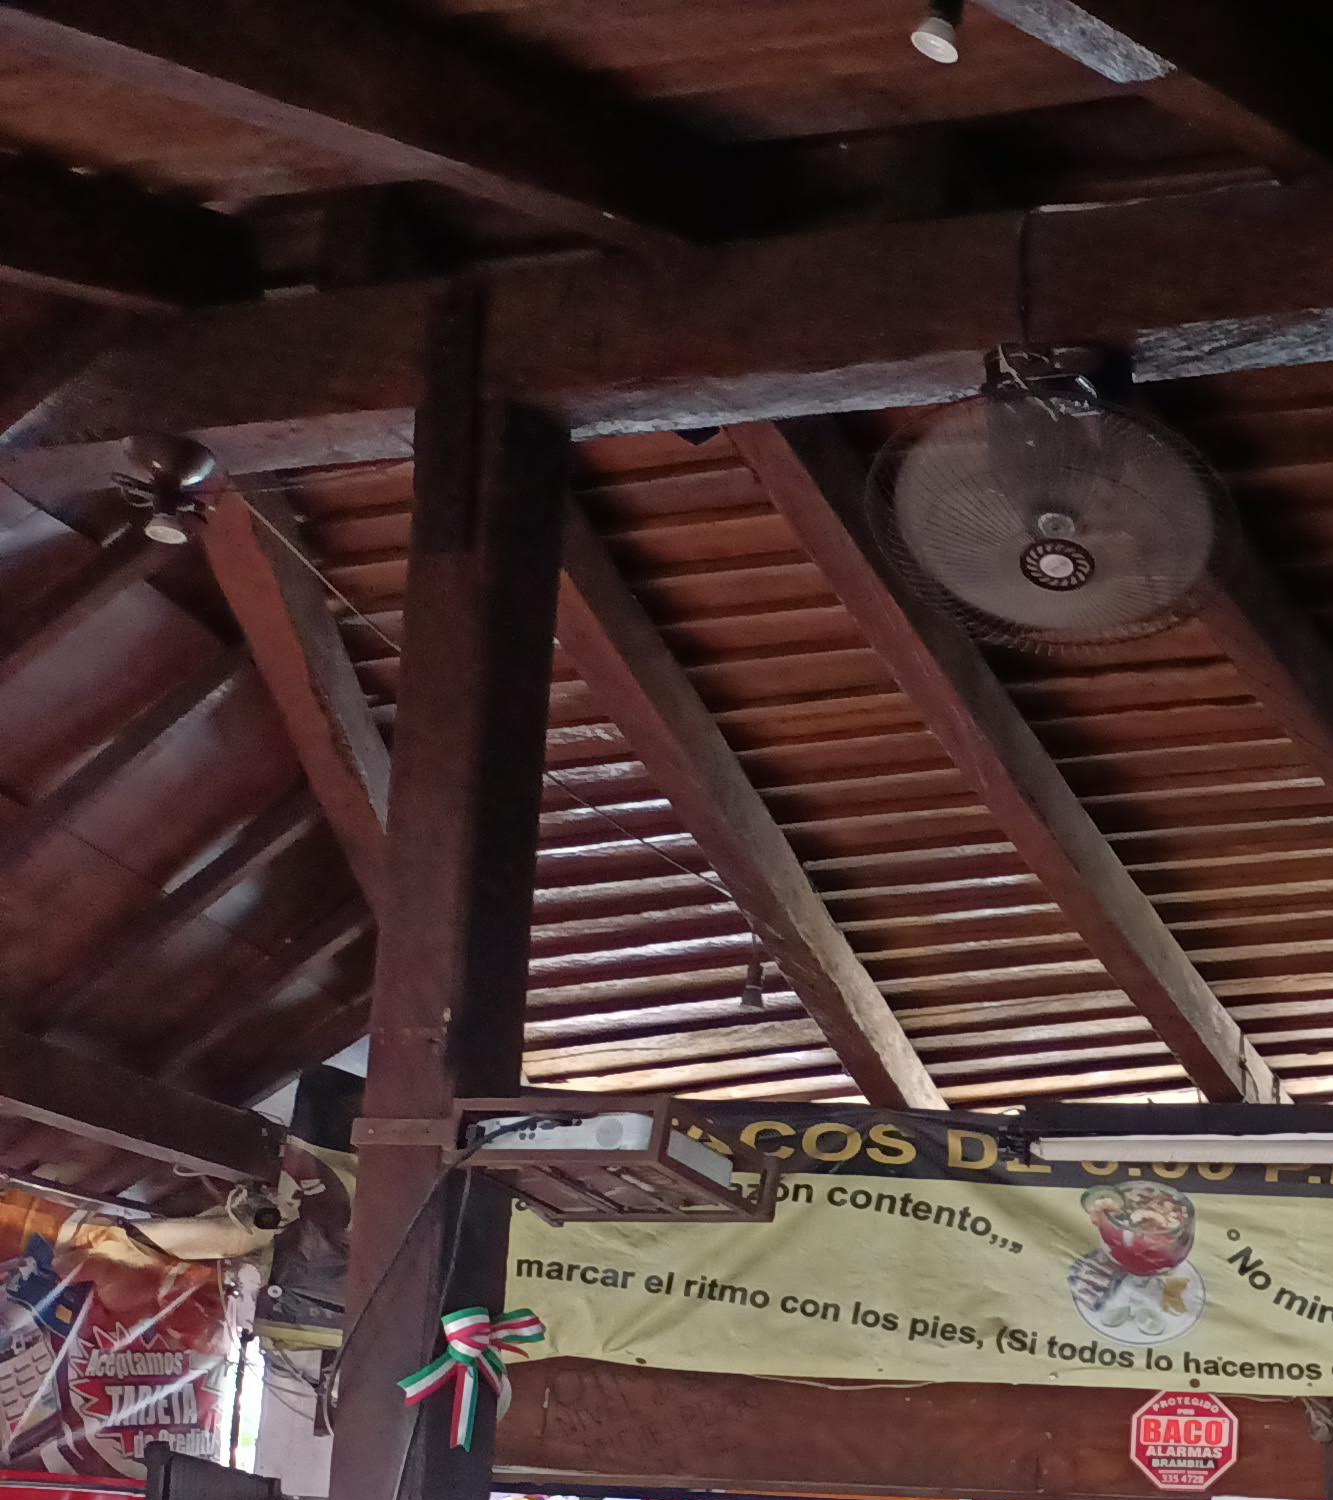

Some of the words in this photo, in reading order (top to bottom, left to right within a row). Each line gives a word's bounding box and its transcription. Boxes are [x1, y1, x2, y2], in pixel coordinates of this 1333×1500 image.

[1228, 1246, 1272, 1291] No
[516, 1257, 637, 1289] marcar
[644, 1272, 674, 1295] el
[684, 1276, 770, 1309] ritmo
[780, 1295, 840, 1322] con
[852, 1300, 899, 1332] los
[909, 1316, 984, 1350] pies,
[996, 1325, 1038, 1356] (Si
[1047, 1335, 1134, 1369] todos
[1145, 1348, 1173, 1372] lo
[1184, 1353, 1322, 1381] hacemos
[85, 1349, 183, 1378] Aceptamos
[1143, 1418, 1223, 1446] BACO
[1145, 1445, 1223, 1459] ALARMAS
